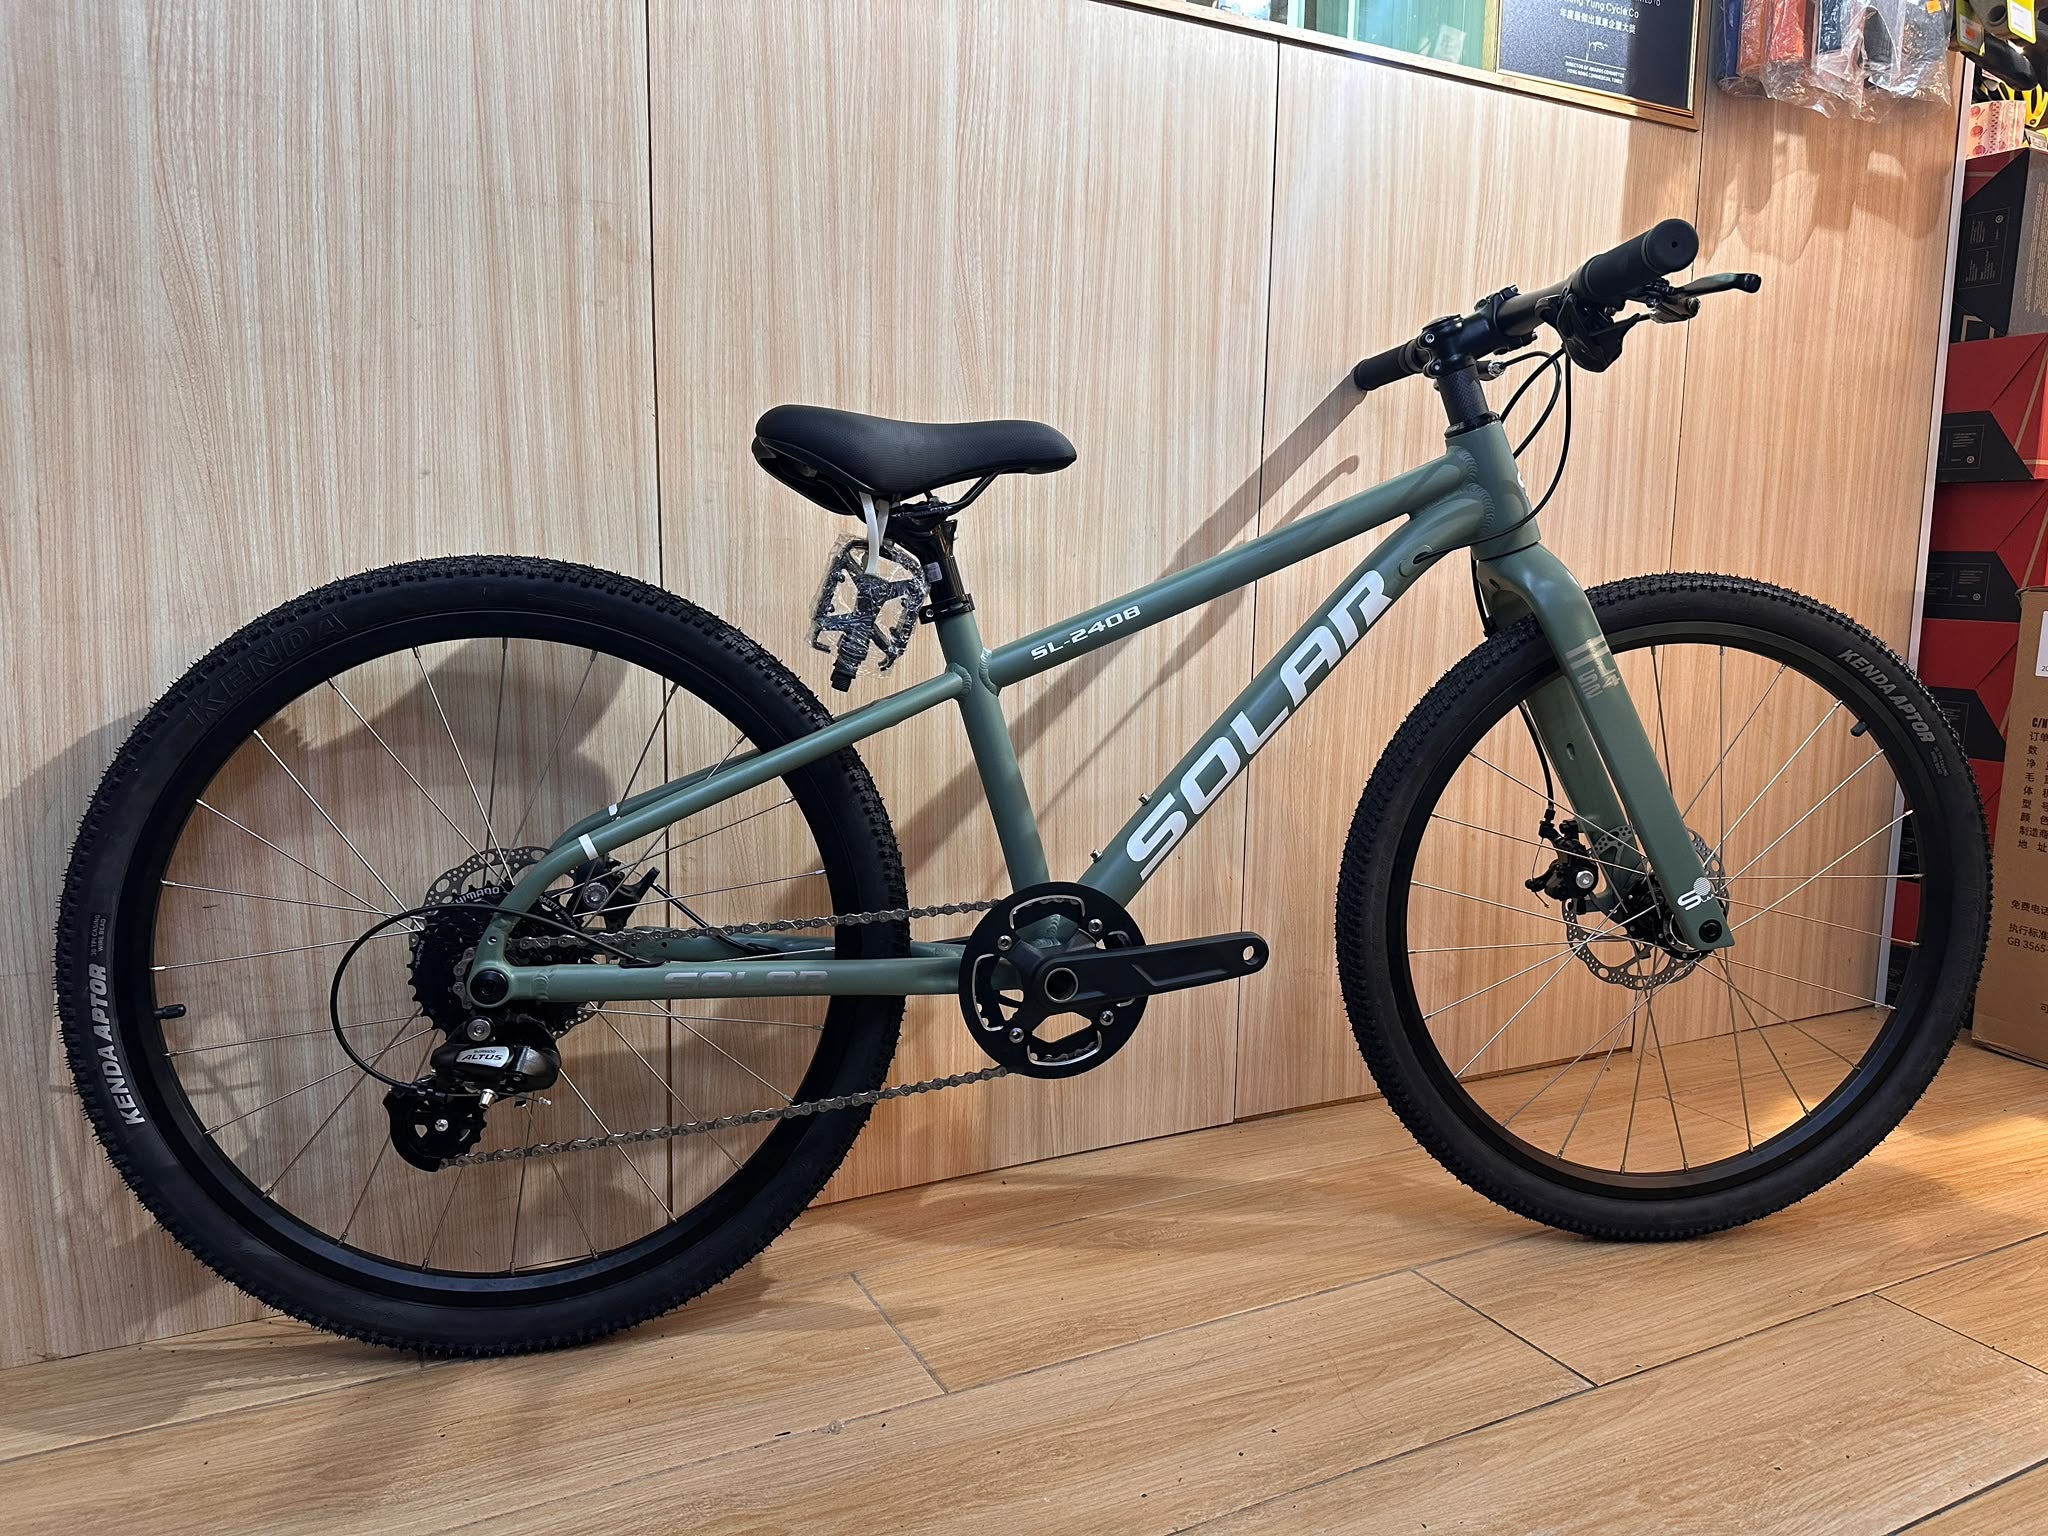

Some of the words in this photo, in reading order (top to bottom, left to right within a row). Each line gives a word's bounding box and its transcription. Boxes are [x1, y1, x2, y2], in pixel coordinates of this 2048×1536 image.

[1605, 2, 1628, 16] Cycle
[1628, 8, 1640, 18] Co
[1031, 605, 1141, 660] SL-2408
[185, 611, 349, 727] KENDA
[1837, 649, 1897, 695] KENDA
[1888, 695, 1936, 742] APTOR
[1126, 570, 1393, 881] SOLAR
[450, 886, 500, 904] HIMANO
[2007, 936, 2021, 947] GB
[88, 963, 113, 1042] APTOR
[664, 970, 829, 990] SOLAR
[98, 1045, 146, 1126] KENDA
